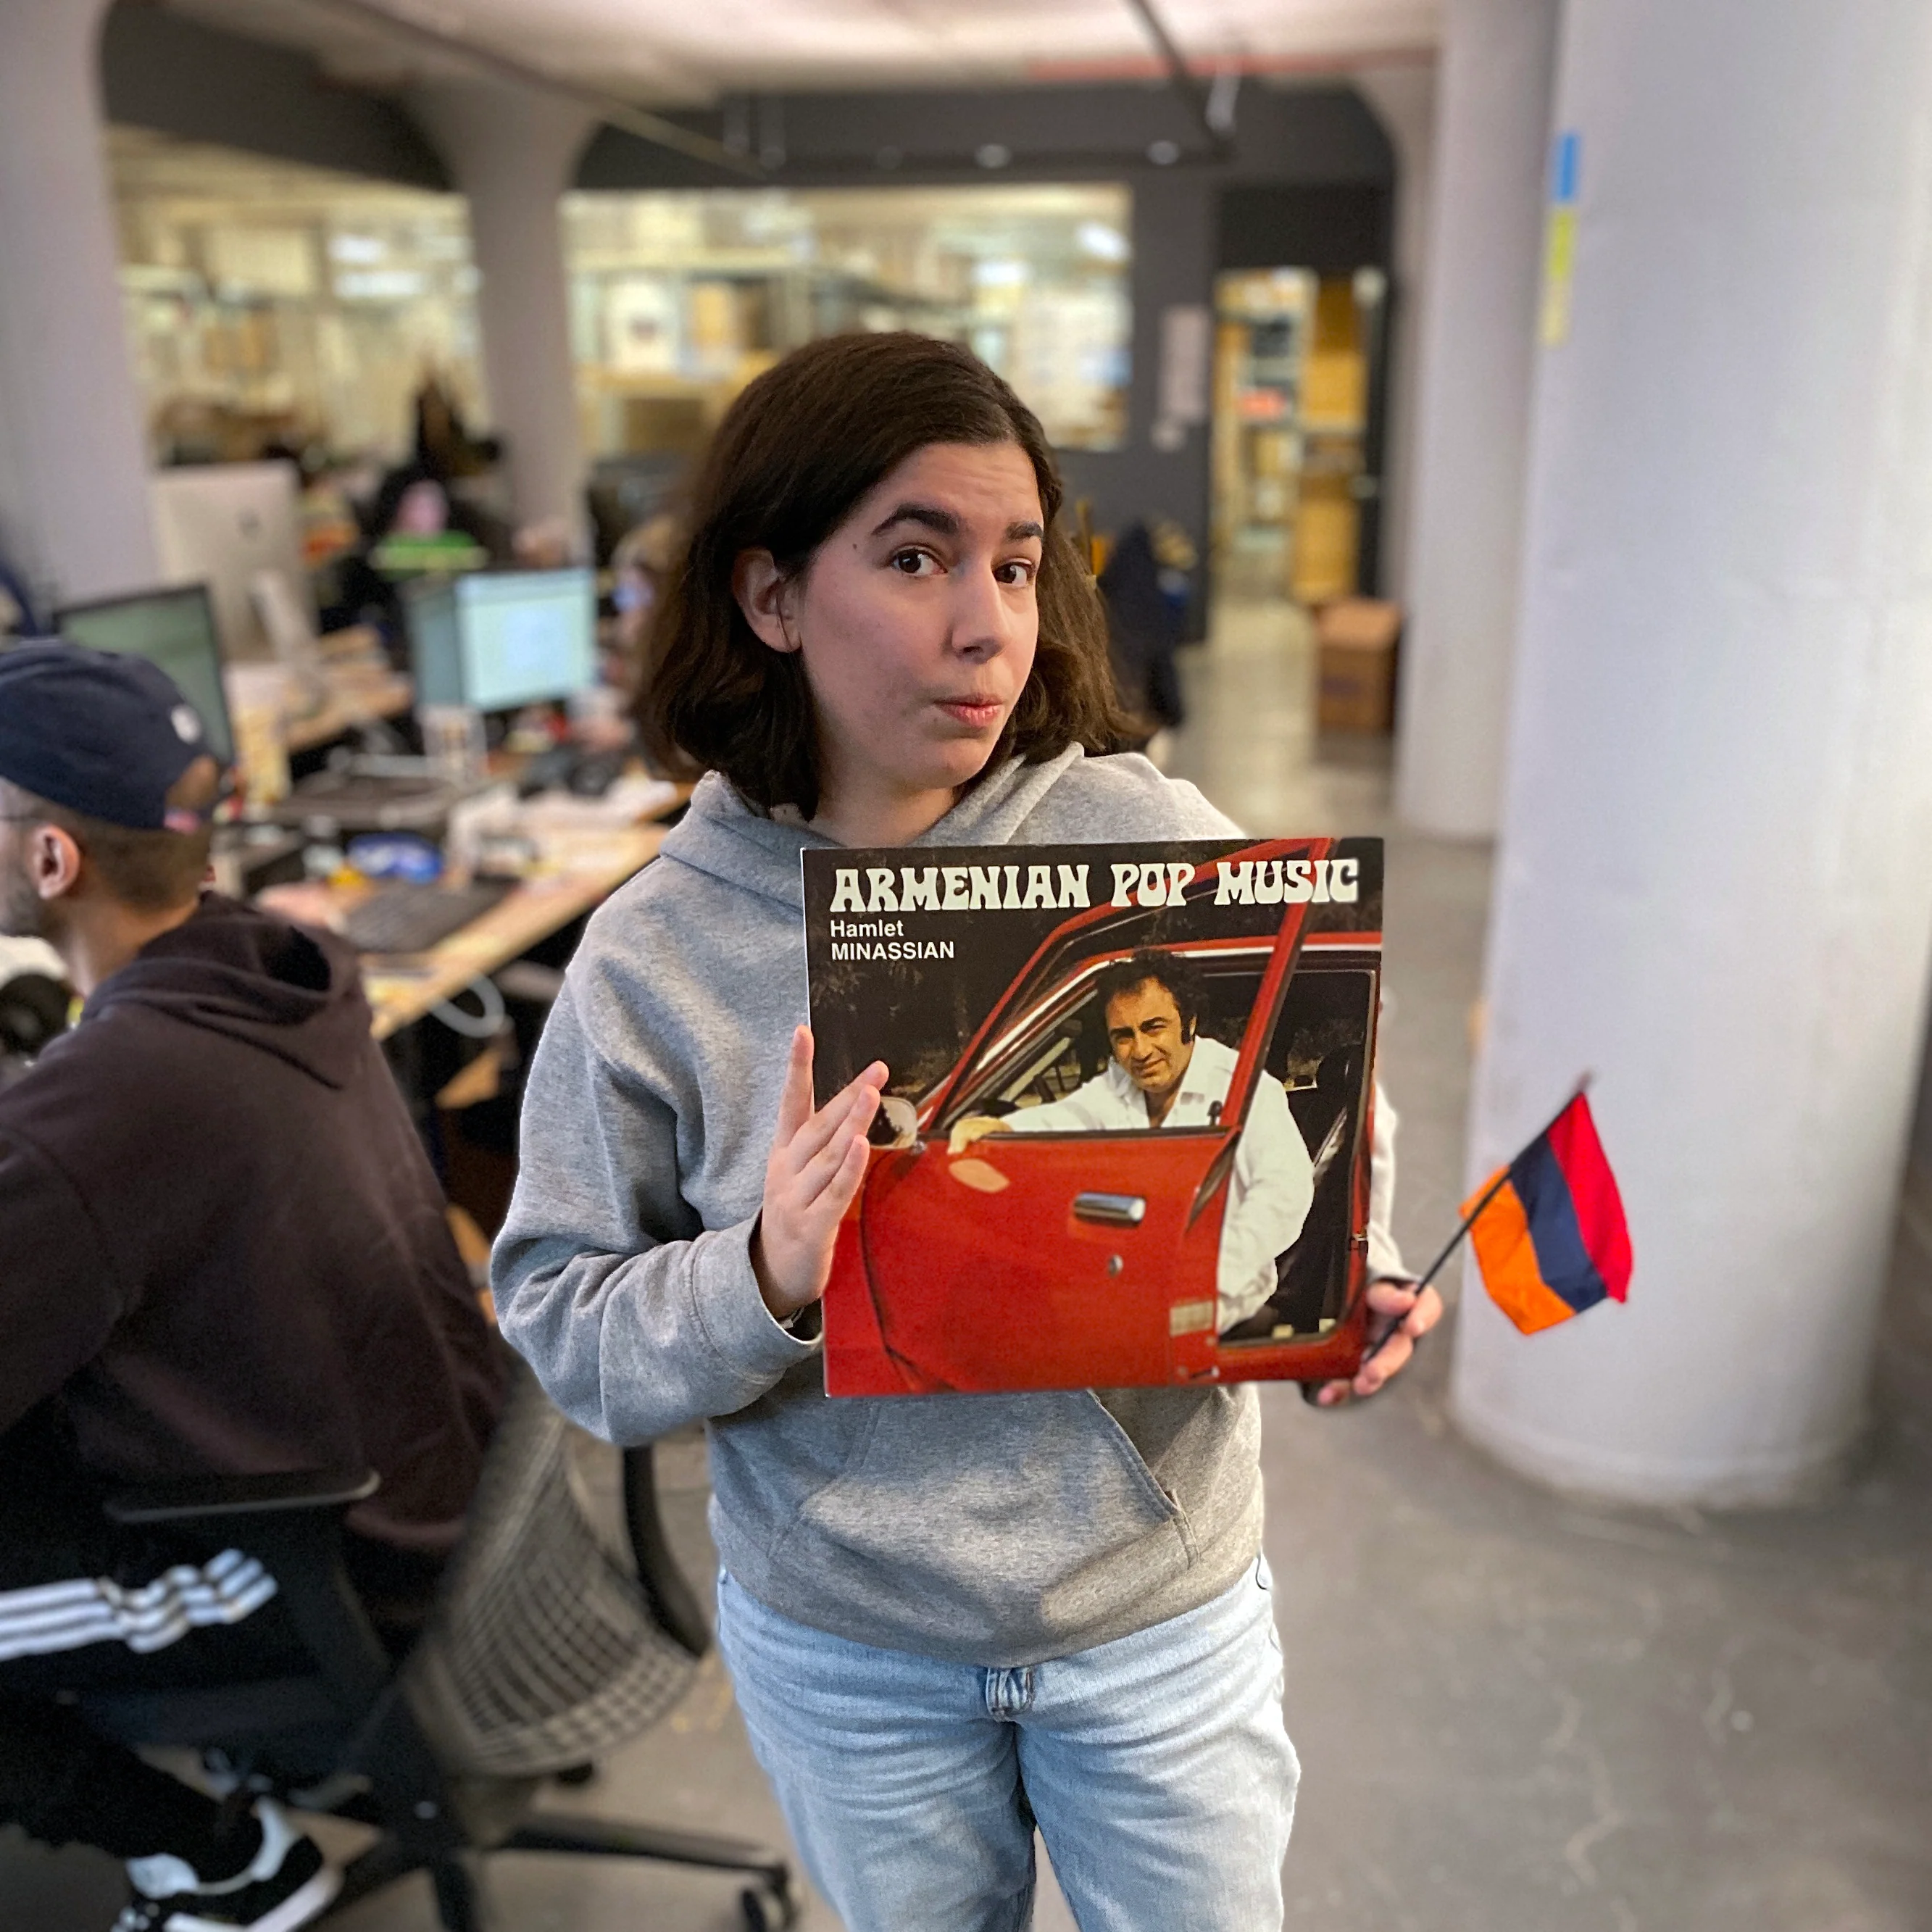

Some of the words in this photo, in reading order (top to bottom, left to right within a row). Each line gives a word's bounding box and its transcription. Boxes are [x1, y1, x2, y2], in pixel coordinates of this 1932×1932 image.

[830, 865, 1090, 912] ARMENIAN
[1111, 863, 1195, 907] POP
[1214, 858, 1359, 906] MUSIC
[830, 919, 904, 938] Hamlet
[830, 941, 955, 961] MINASSIAN
